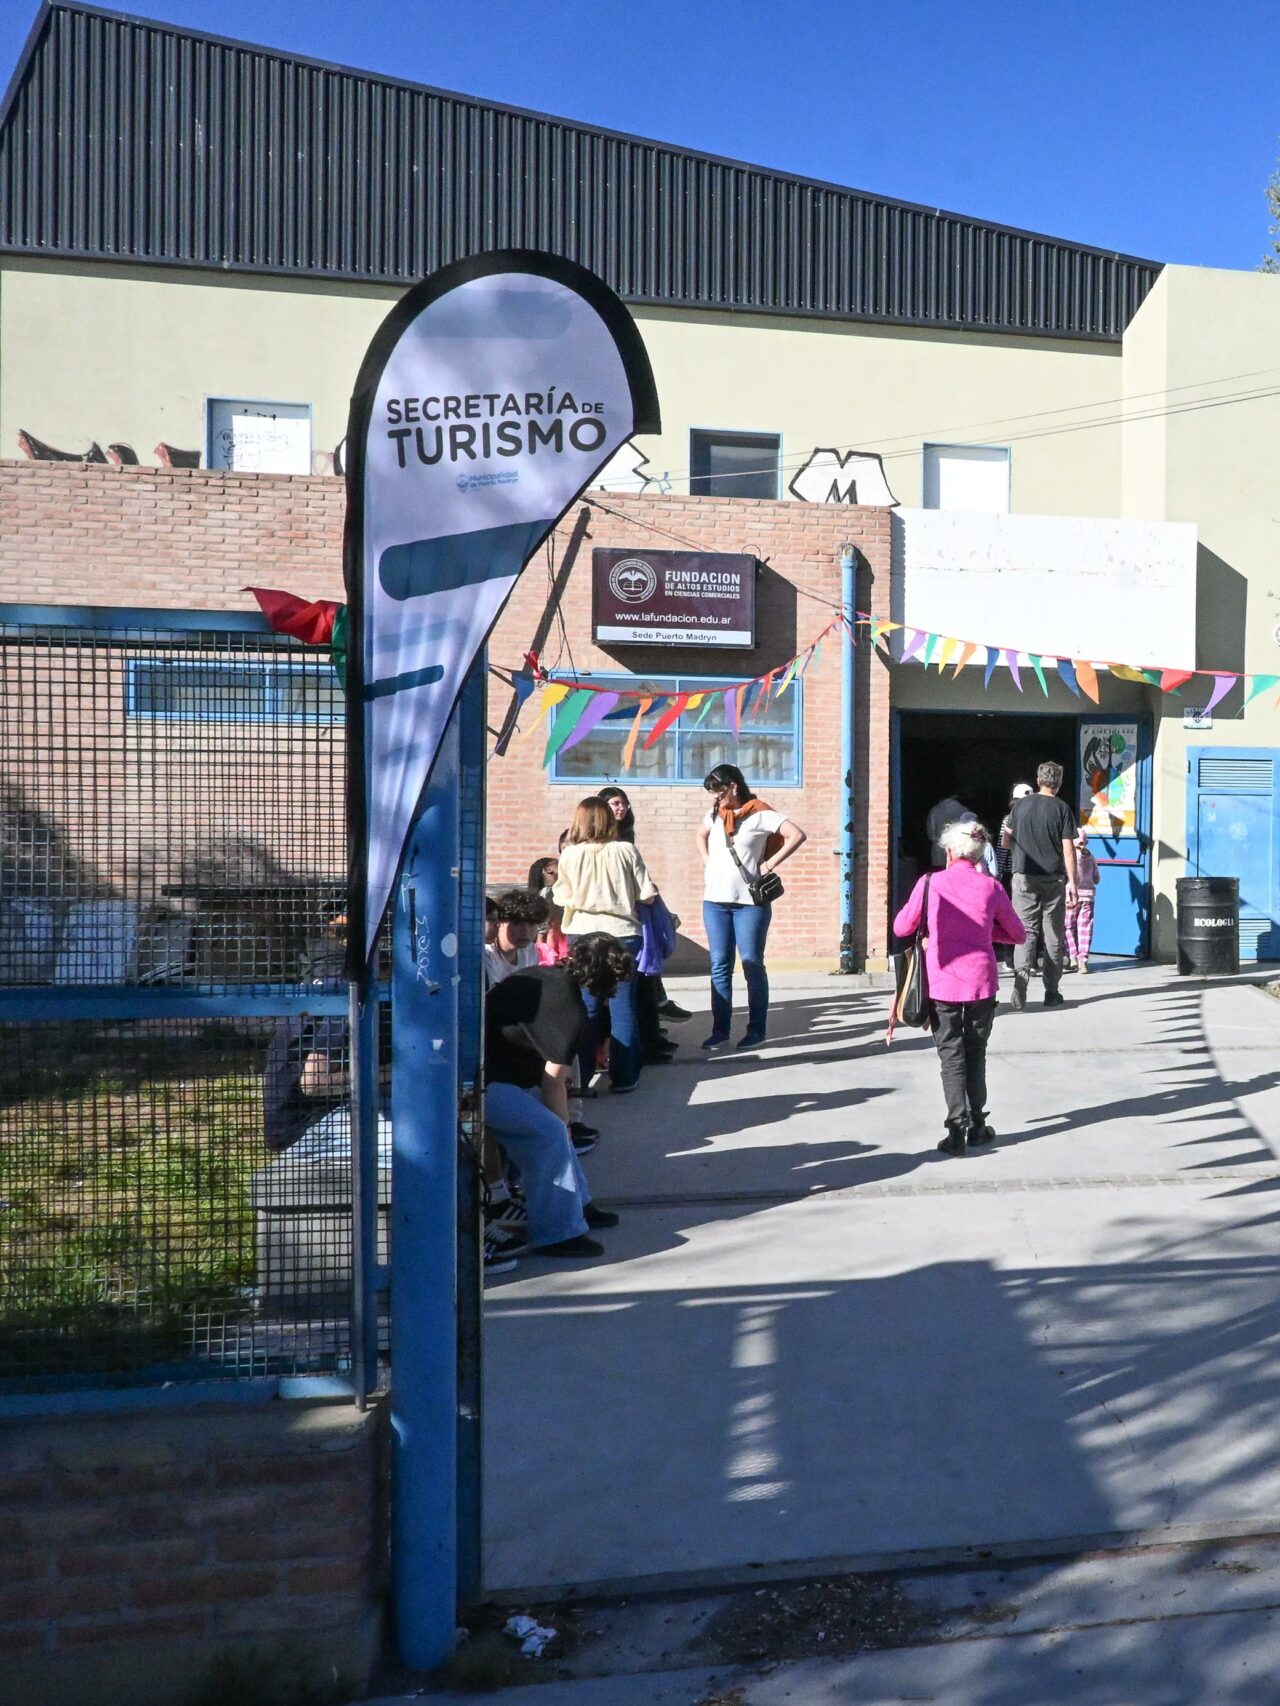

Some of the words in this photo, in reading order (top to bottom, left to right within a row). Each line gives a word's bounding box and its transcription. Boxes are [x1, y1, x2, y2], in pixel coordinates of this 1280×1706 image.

[386, 386, 578, 424] SECRETARÍA
[581, 402, 604, 414] DE
[387, 417, 606, 468] TURISMO
[665, 570, 740, 585] FUNDACION
[703, 585, 740, 593] ESTUDIOS
[615, 612, 732, 625] www.lafundacion.edu.ar
[632, 631, 653, 639] Sede
[656, 632, 684, 641] Puerto
[686, 634, 717, 643] Madryn
